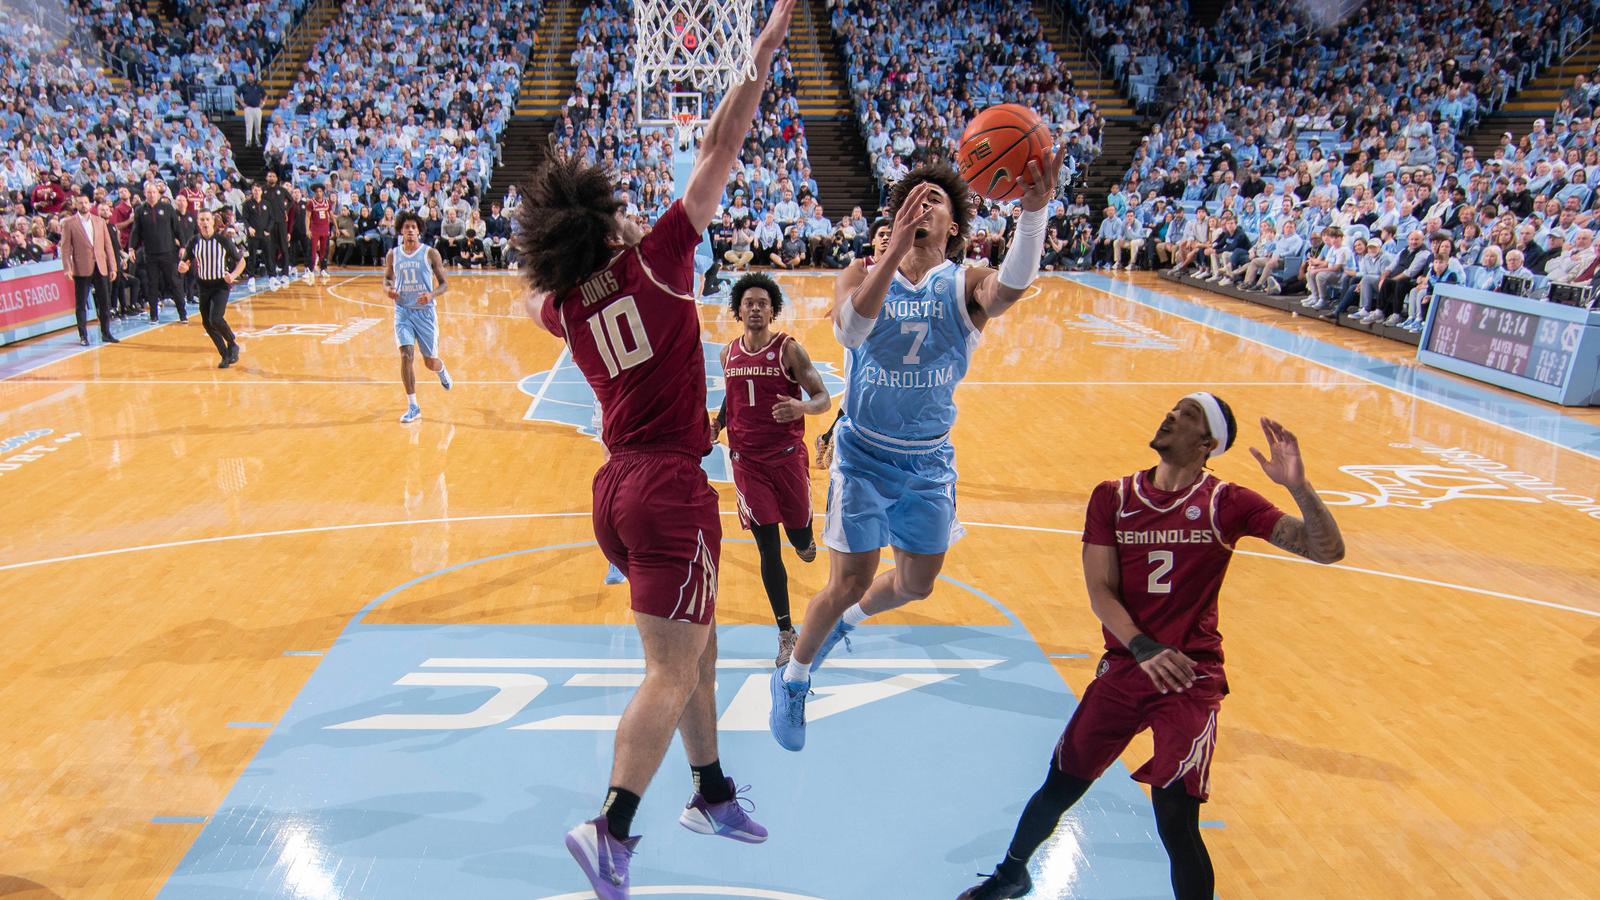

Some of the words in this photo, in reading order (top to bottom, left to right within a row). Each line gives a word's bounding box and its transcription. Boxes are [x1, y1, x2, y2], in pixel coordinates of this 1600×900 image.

[402, 269, 418, 284] 11
[579, 270, 619, 307] JONES
[24, 282, 60, 307] FARGO
[884, 300, 944, 320] NORTH
[1456, 303, 1472, 325] 46
[1497, 312, 1529, 337] 13:14
[1539, 320, 1558, 344] 53
[586, 295, 654, 379] 10
[900, 321, 929, 365] 7
[726, 366, 780, 378] SEMINOLES
[865, 365, 953, 388] CAROLINA
[1512, 358, 1520, 373] 2
[746, 379, 755, 407] 1
[1115, 529, 1213, 544] SEMINOLES
[1147, 550, 1174, 593] 2
